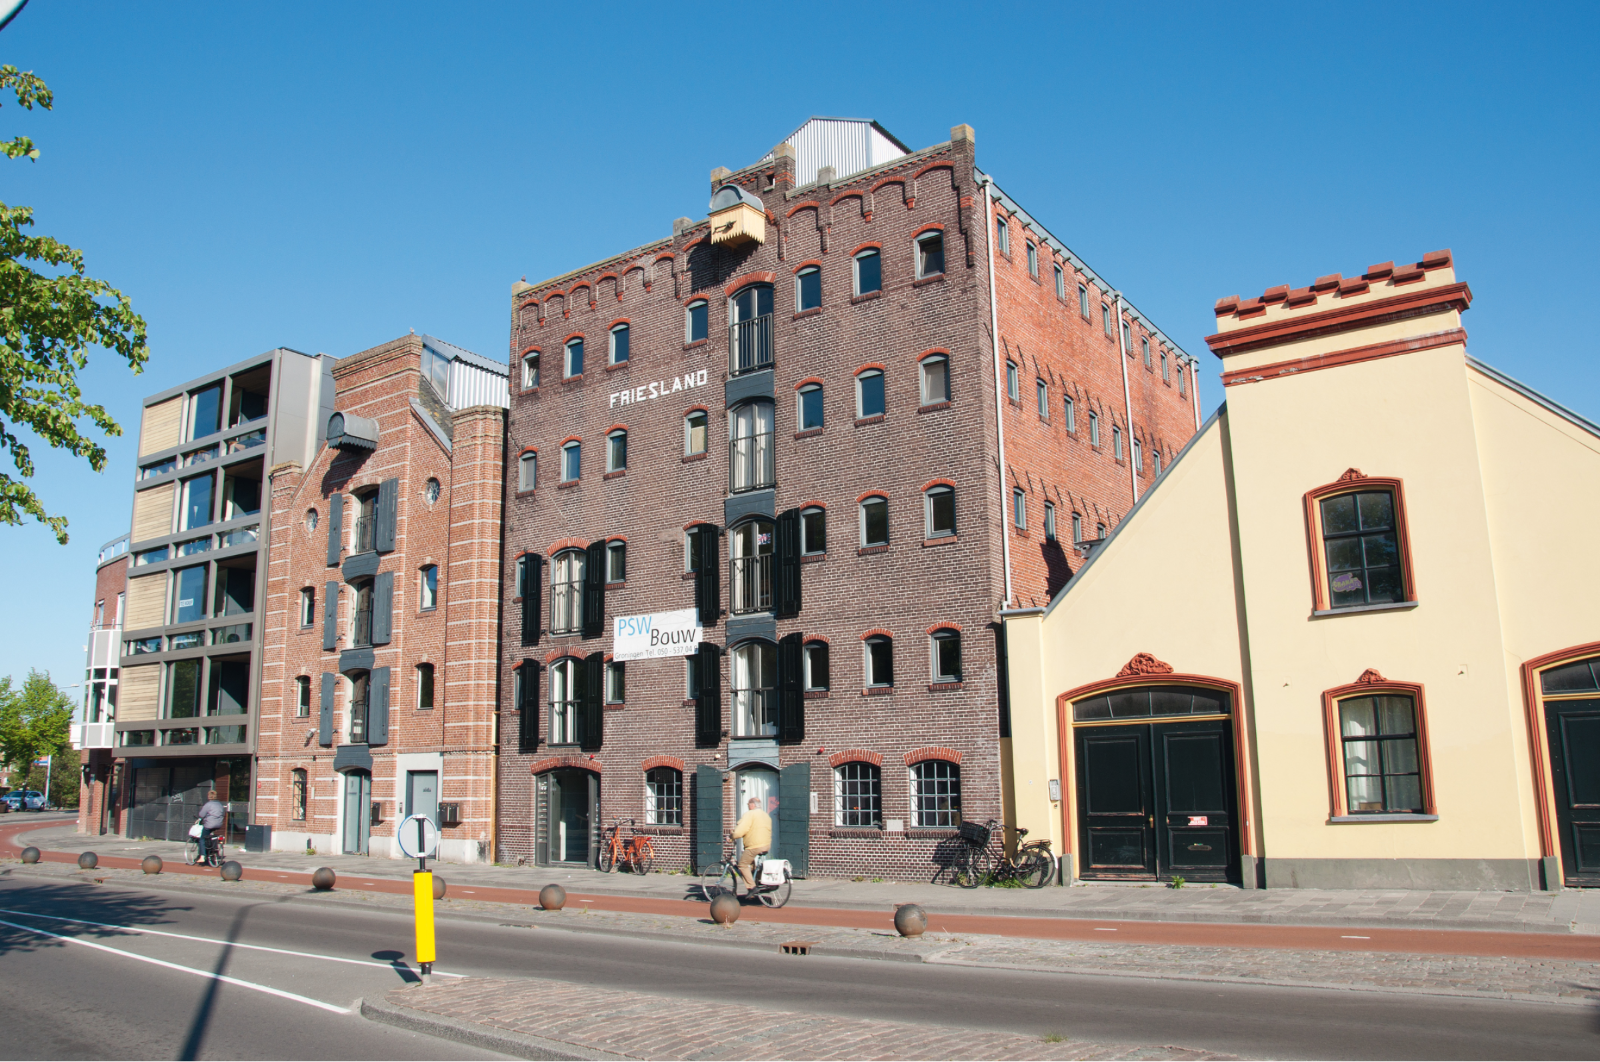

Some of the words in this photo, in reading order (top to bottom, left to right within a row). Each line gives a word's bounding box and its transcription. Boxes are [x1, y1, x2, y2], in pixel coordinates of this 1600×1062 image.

[610, 369, 707, 408] FRIESLAND
[618, 616, 652, 636] PSW
[615, 652, 643, 660] Groningen
